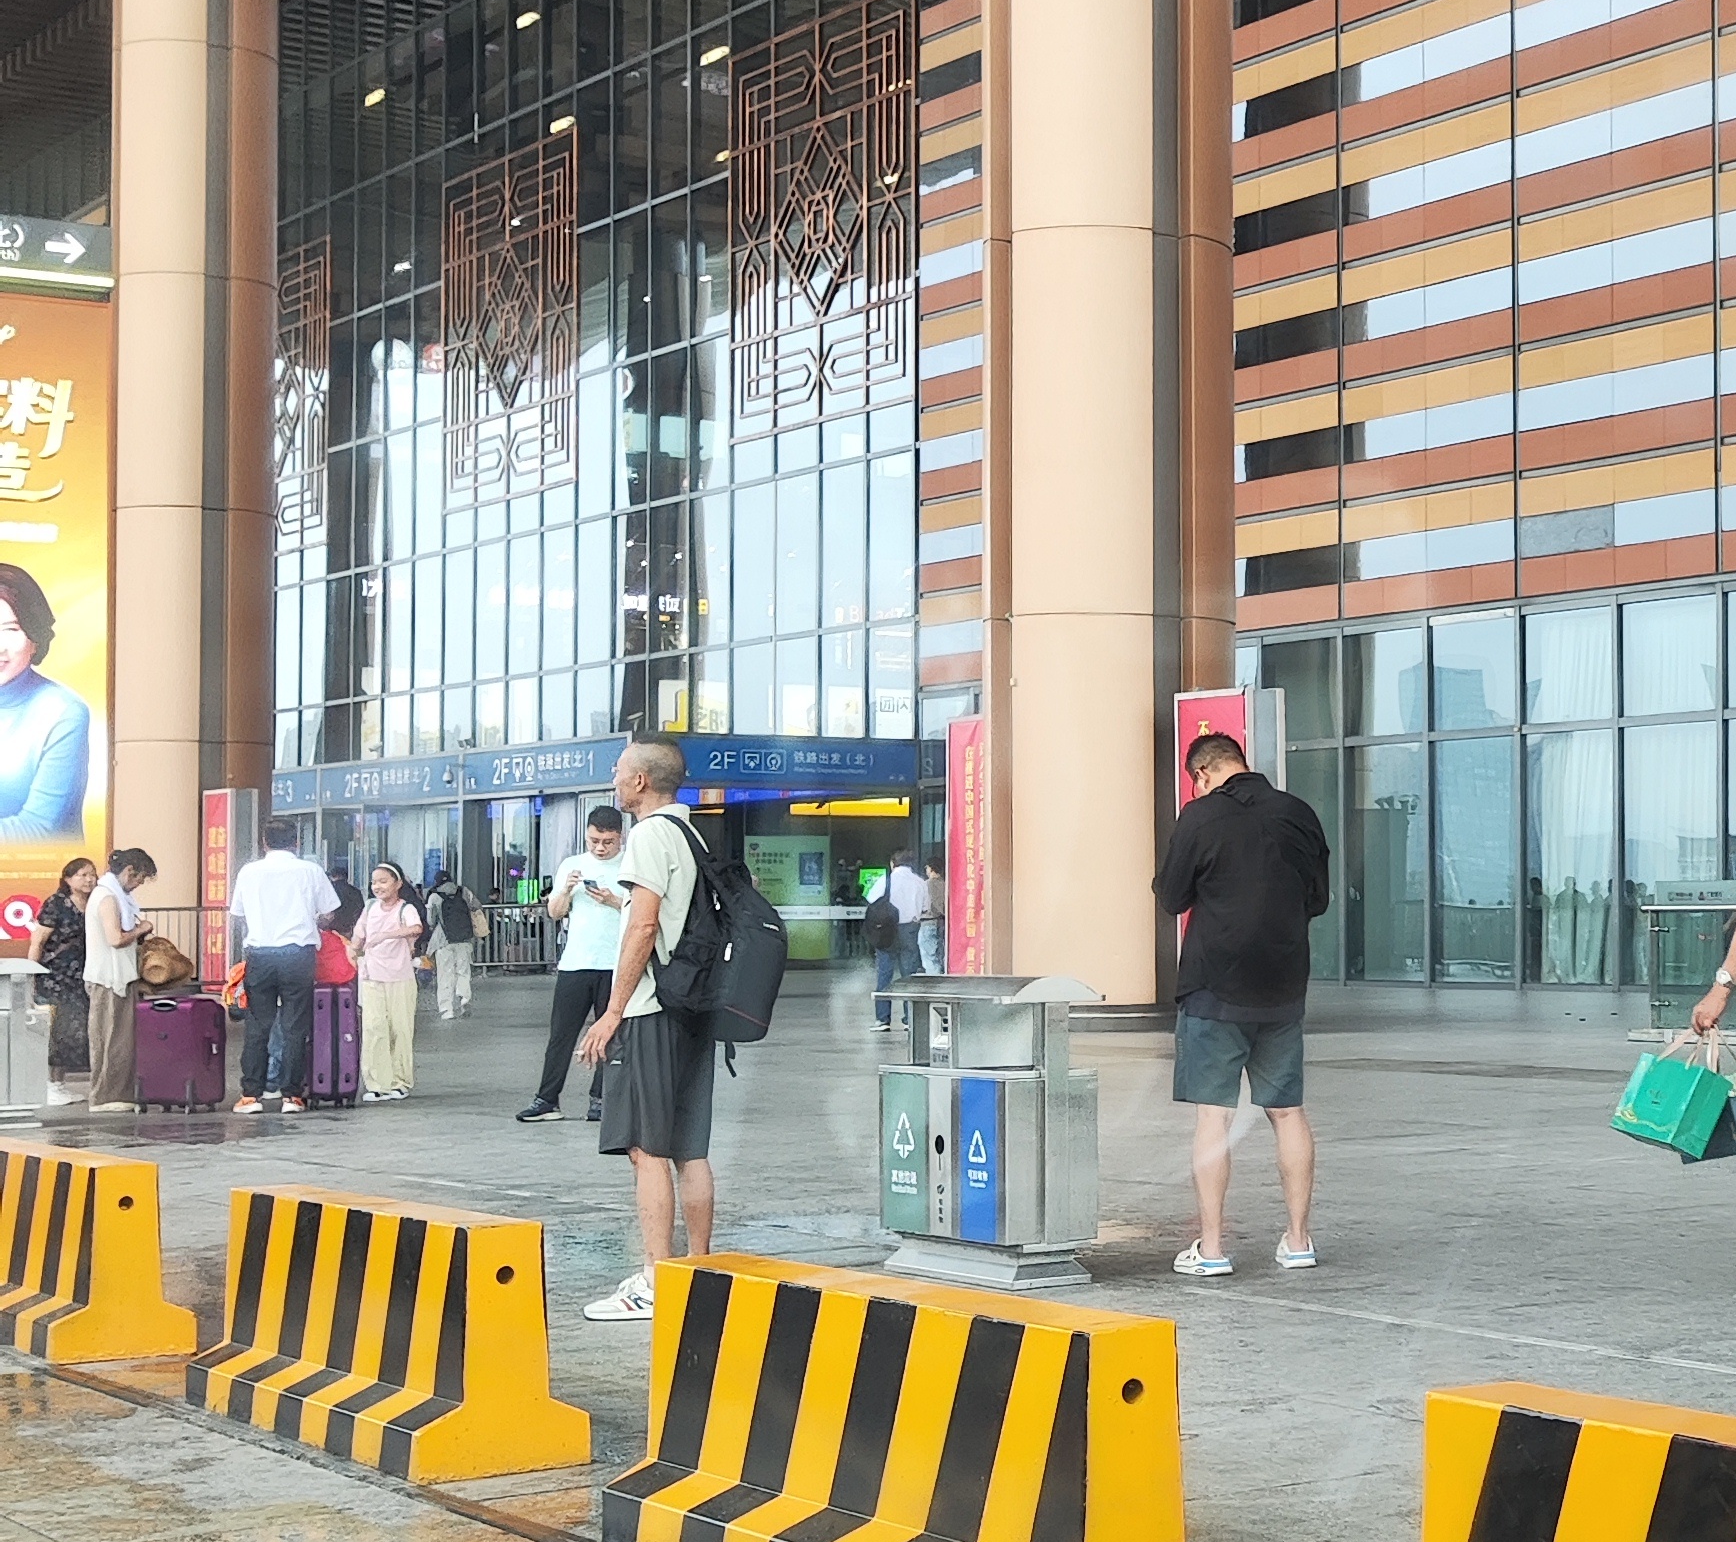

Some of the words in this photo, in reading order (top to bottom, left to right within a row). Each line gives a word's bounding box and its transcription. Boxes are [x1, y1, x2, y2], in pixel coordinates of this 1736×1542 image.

[492, 757, 510, 785] 2F
[709, 751, 738, 770] 2F
[344, 773, 359, 798] 2F
